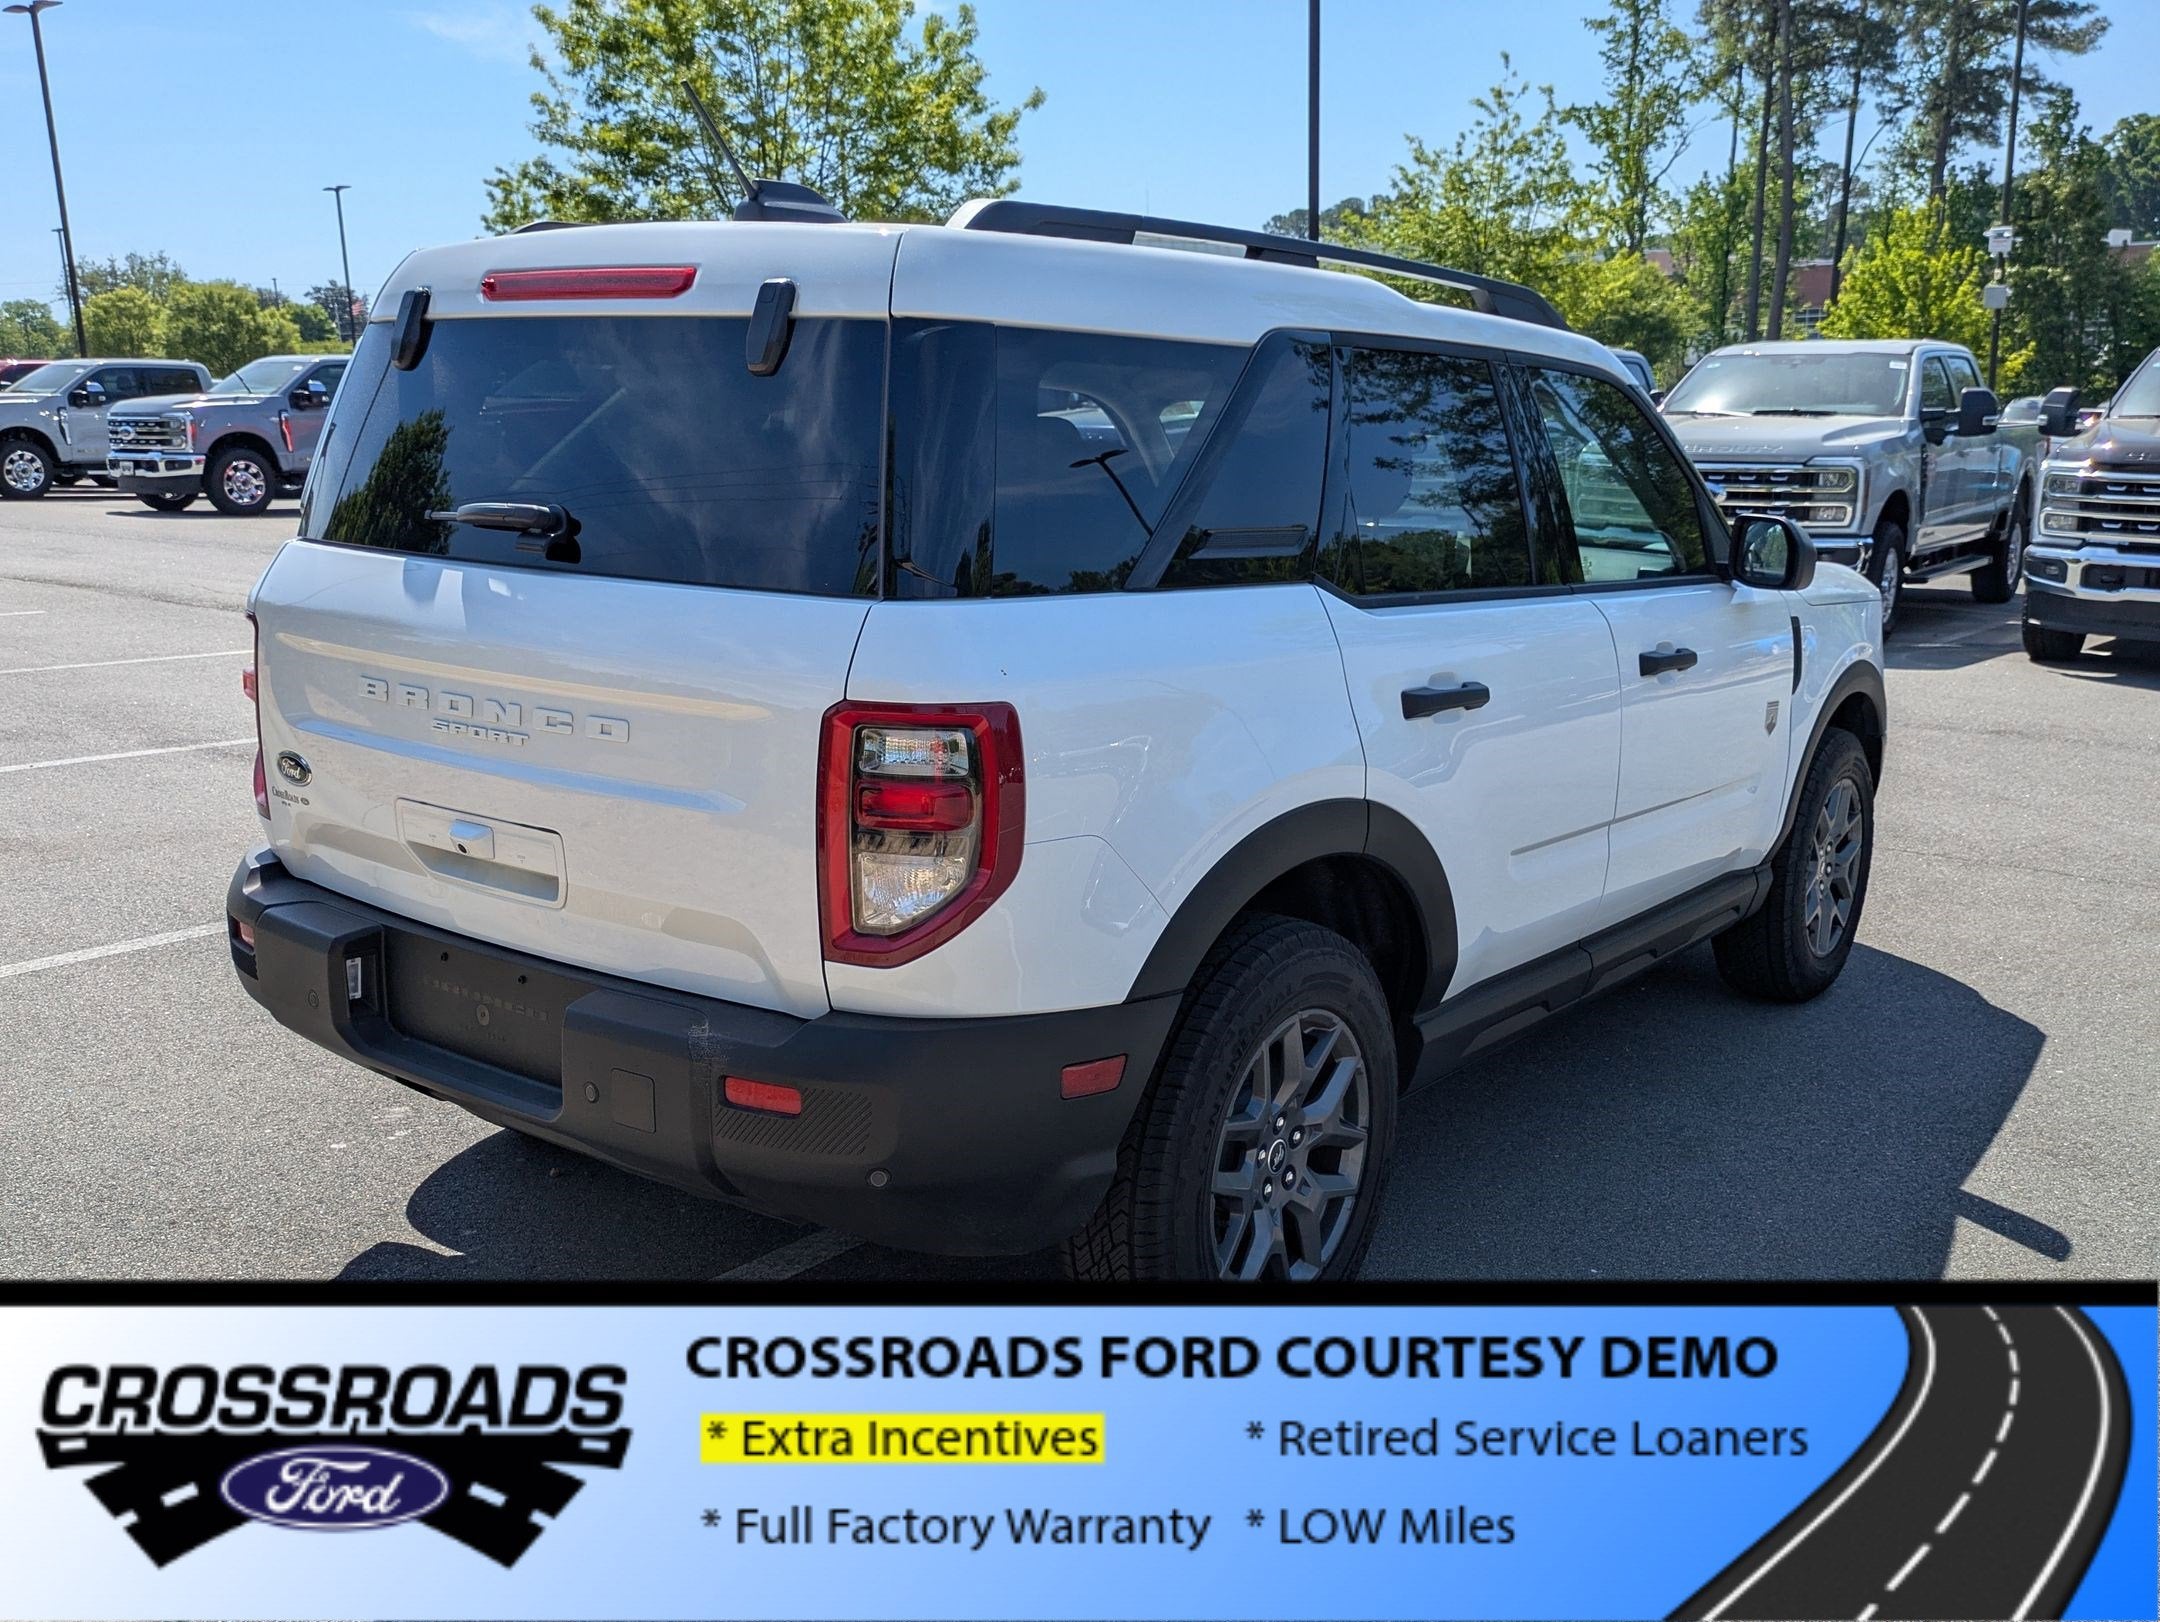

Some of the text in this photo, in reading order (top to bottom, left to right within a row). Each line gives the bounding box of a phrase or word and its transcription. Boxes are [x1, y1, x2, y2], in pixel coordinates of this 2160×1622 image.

[358, 674, 631, 744] BRONCO
[430, 717, 531, 746] SPORT
[280, 757, 302, 780] Ford
